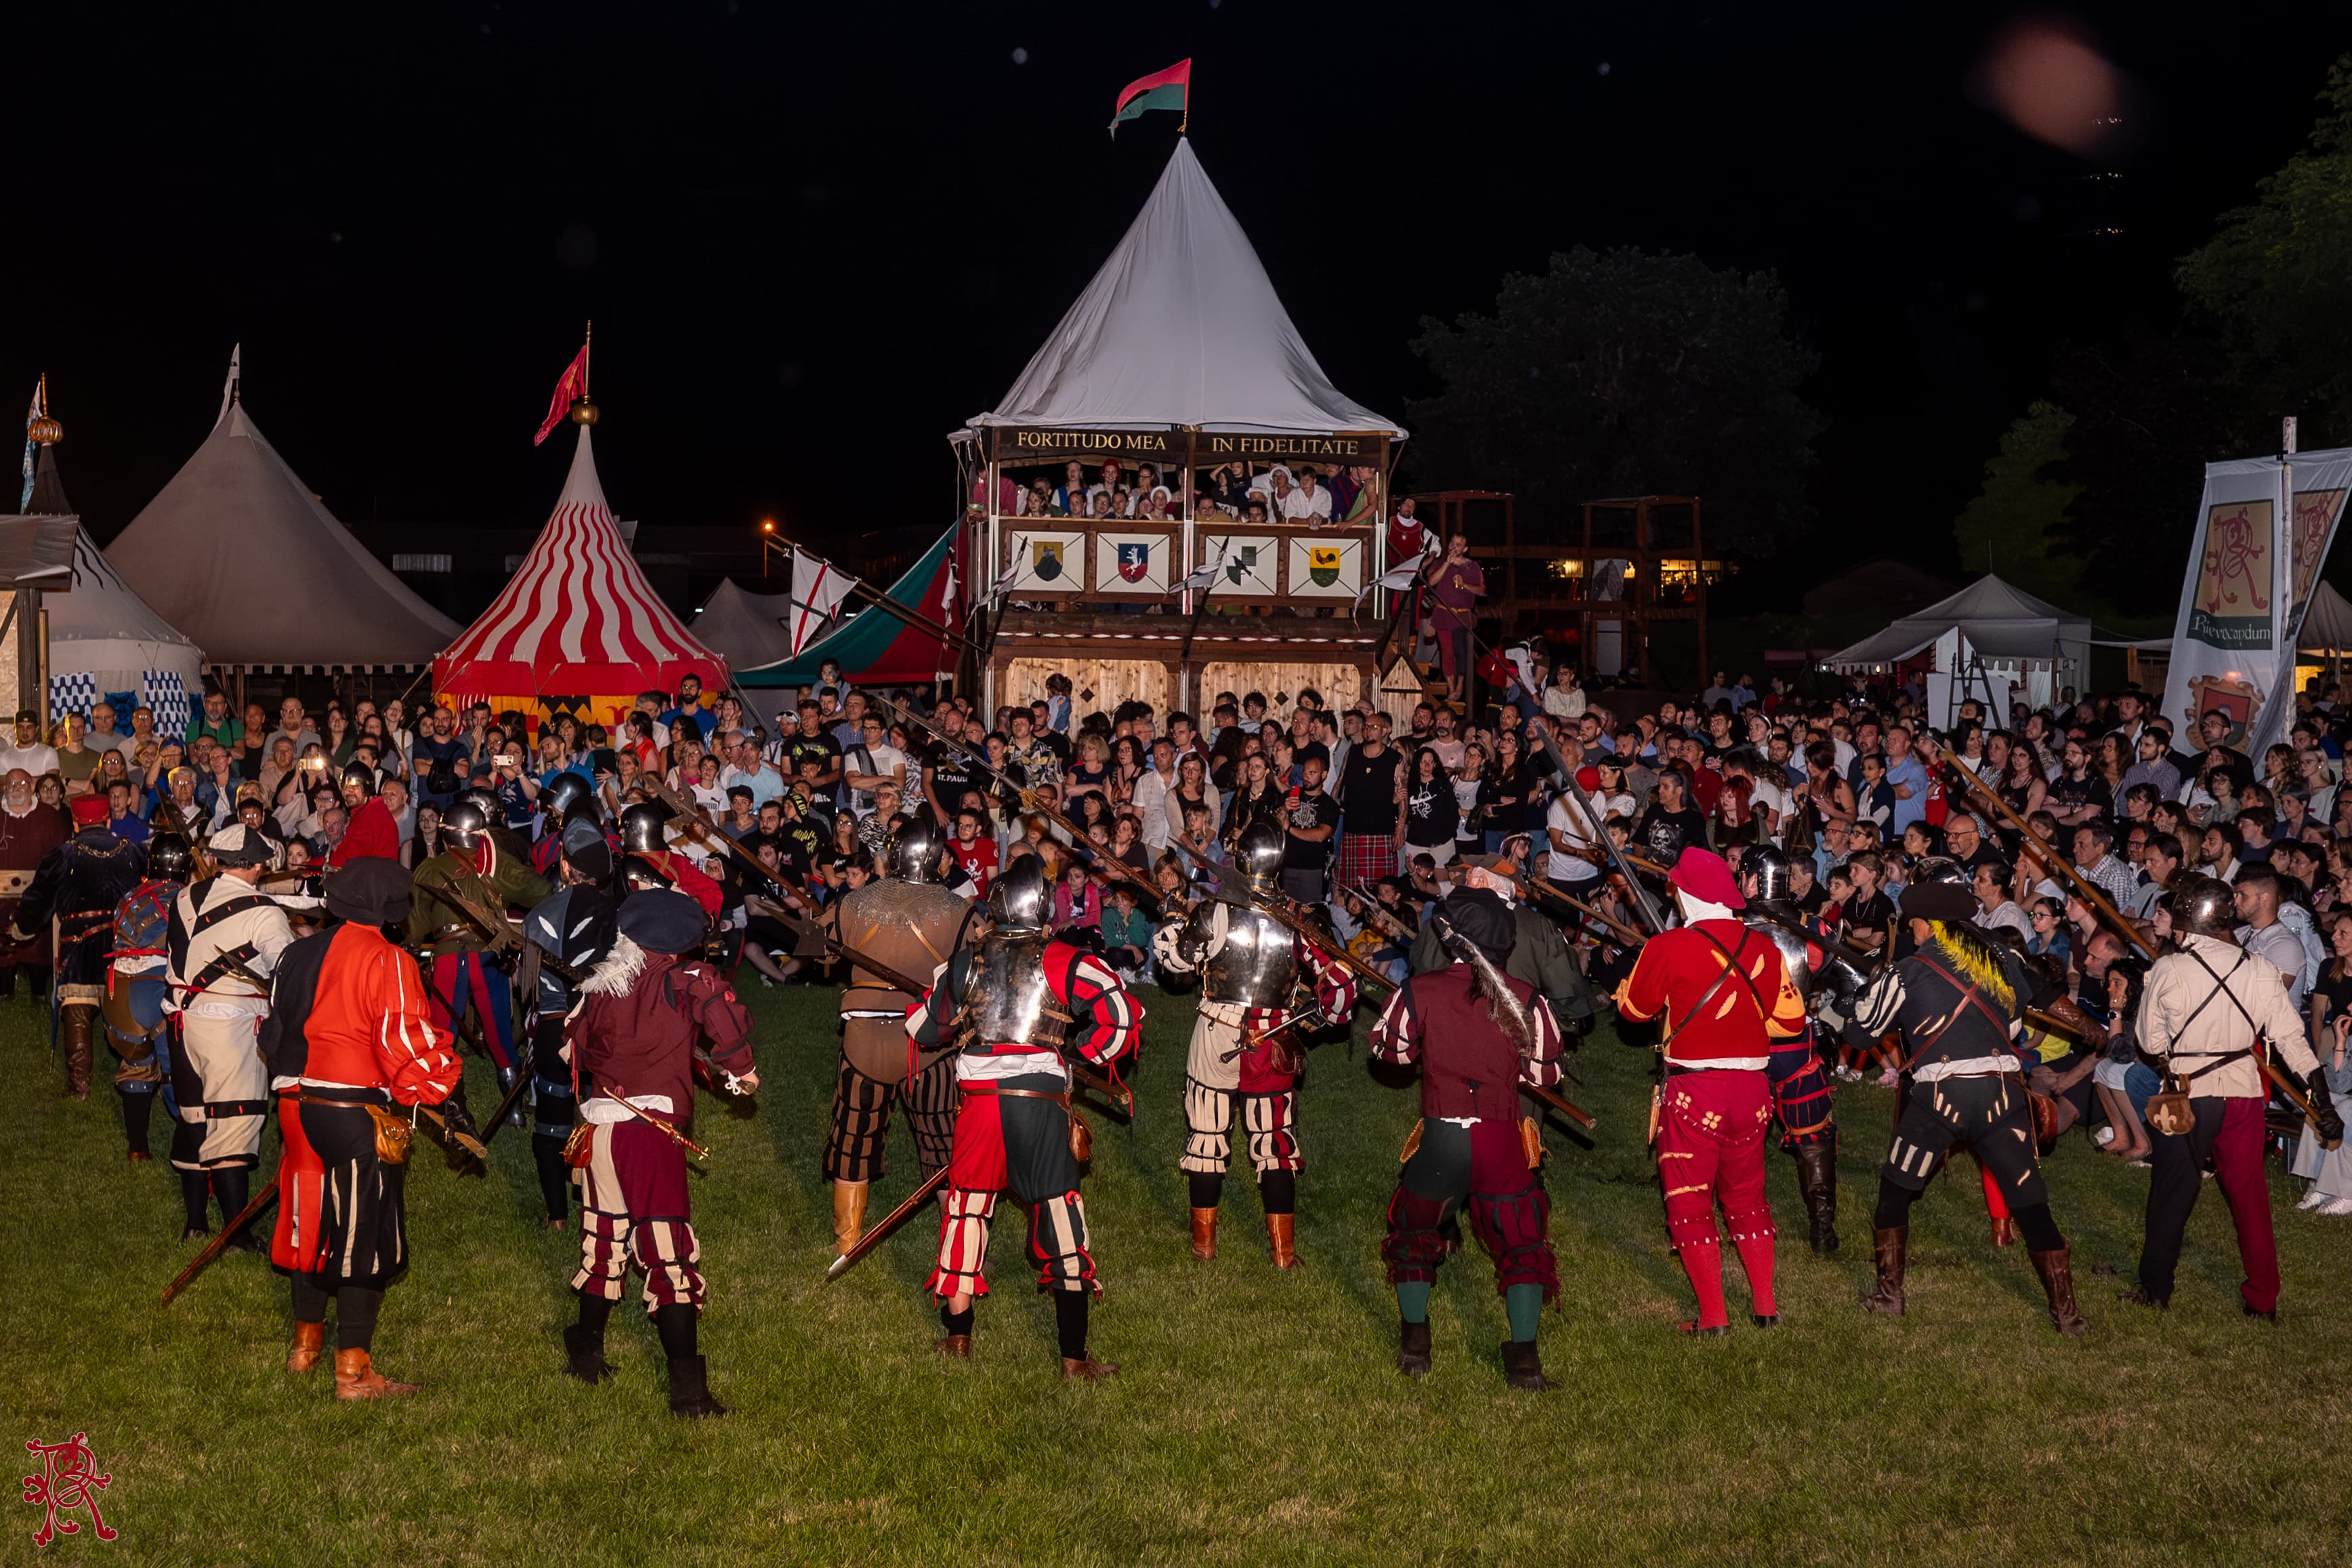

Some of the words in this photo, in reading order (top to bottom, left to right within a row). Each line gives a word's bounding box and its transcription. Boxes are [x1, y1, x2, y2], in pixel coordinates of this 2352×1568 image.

[1017, 431, 1122, 449] FORTITUDO
[1125, 435, 1167, 450] MEA
[1211, 437, 1234, 452] IN
[1240, 438, 1359, 455] FIDELITATE
[946, 774, 969, 782] PAULI
